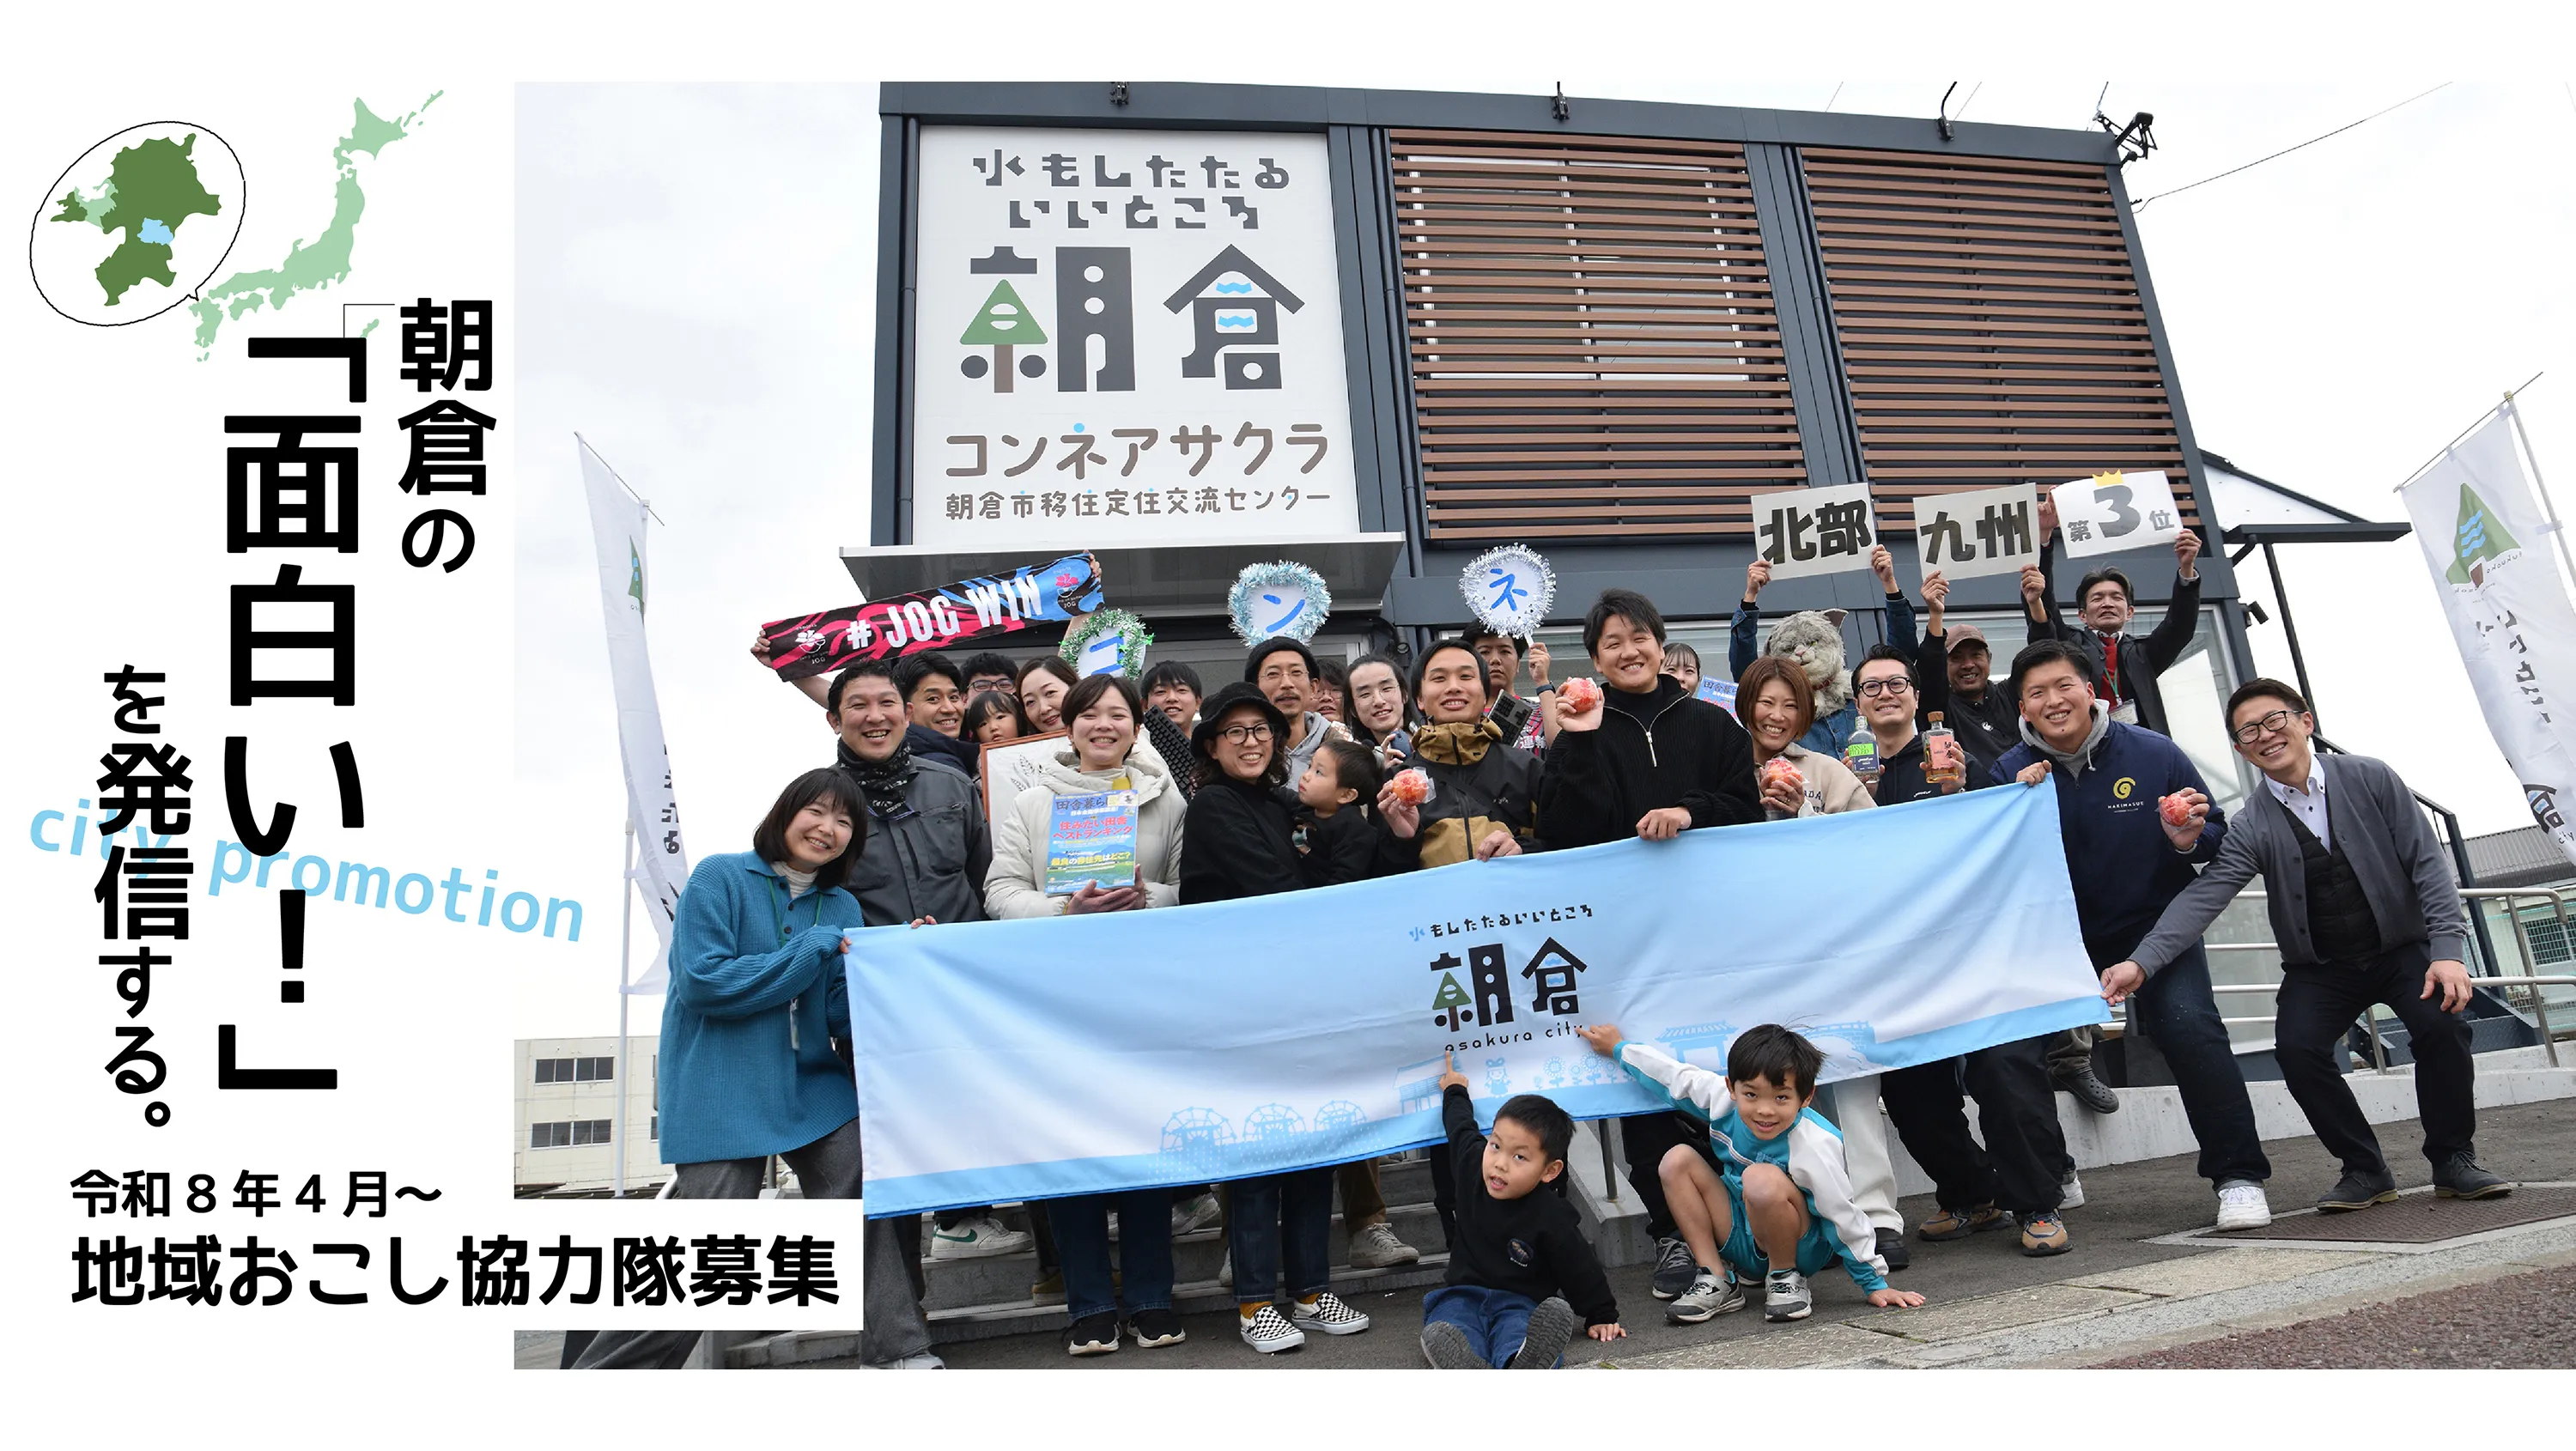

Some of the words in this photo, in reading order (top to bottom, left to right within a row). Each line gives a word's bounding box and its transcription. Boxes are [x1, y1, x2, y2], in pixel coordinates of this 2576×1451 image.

[974, 149, 1289, 188] 水もしたたる
[1010, 196, 1258, 228] いいところ
[960, 244, 1304, 393] 朝倉
[946, 422, 1327, 480] コンネアサクラ
[946, 486, 1330, 519] 朝倉市移住定住交流センター
[1760, 499, 1872, 565] 北部
[1920, 501, 2032, 565] 九州
[1489, 568, 1528, 611] ネ
[886, 595, 961, 648] JOG
[965, 574, 1042, 628] WIN
[1263, 594, 1305, 633] ン
[1059, 816, 1127, 830] 住みたい田舎
[1409, 904, 1593, 942] 水もしたたるいいところ
[1430, 937, 1588, 1033] 朝倉
[1444, 1033, 1533, 1053] asakura
